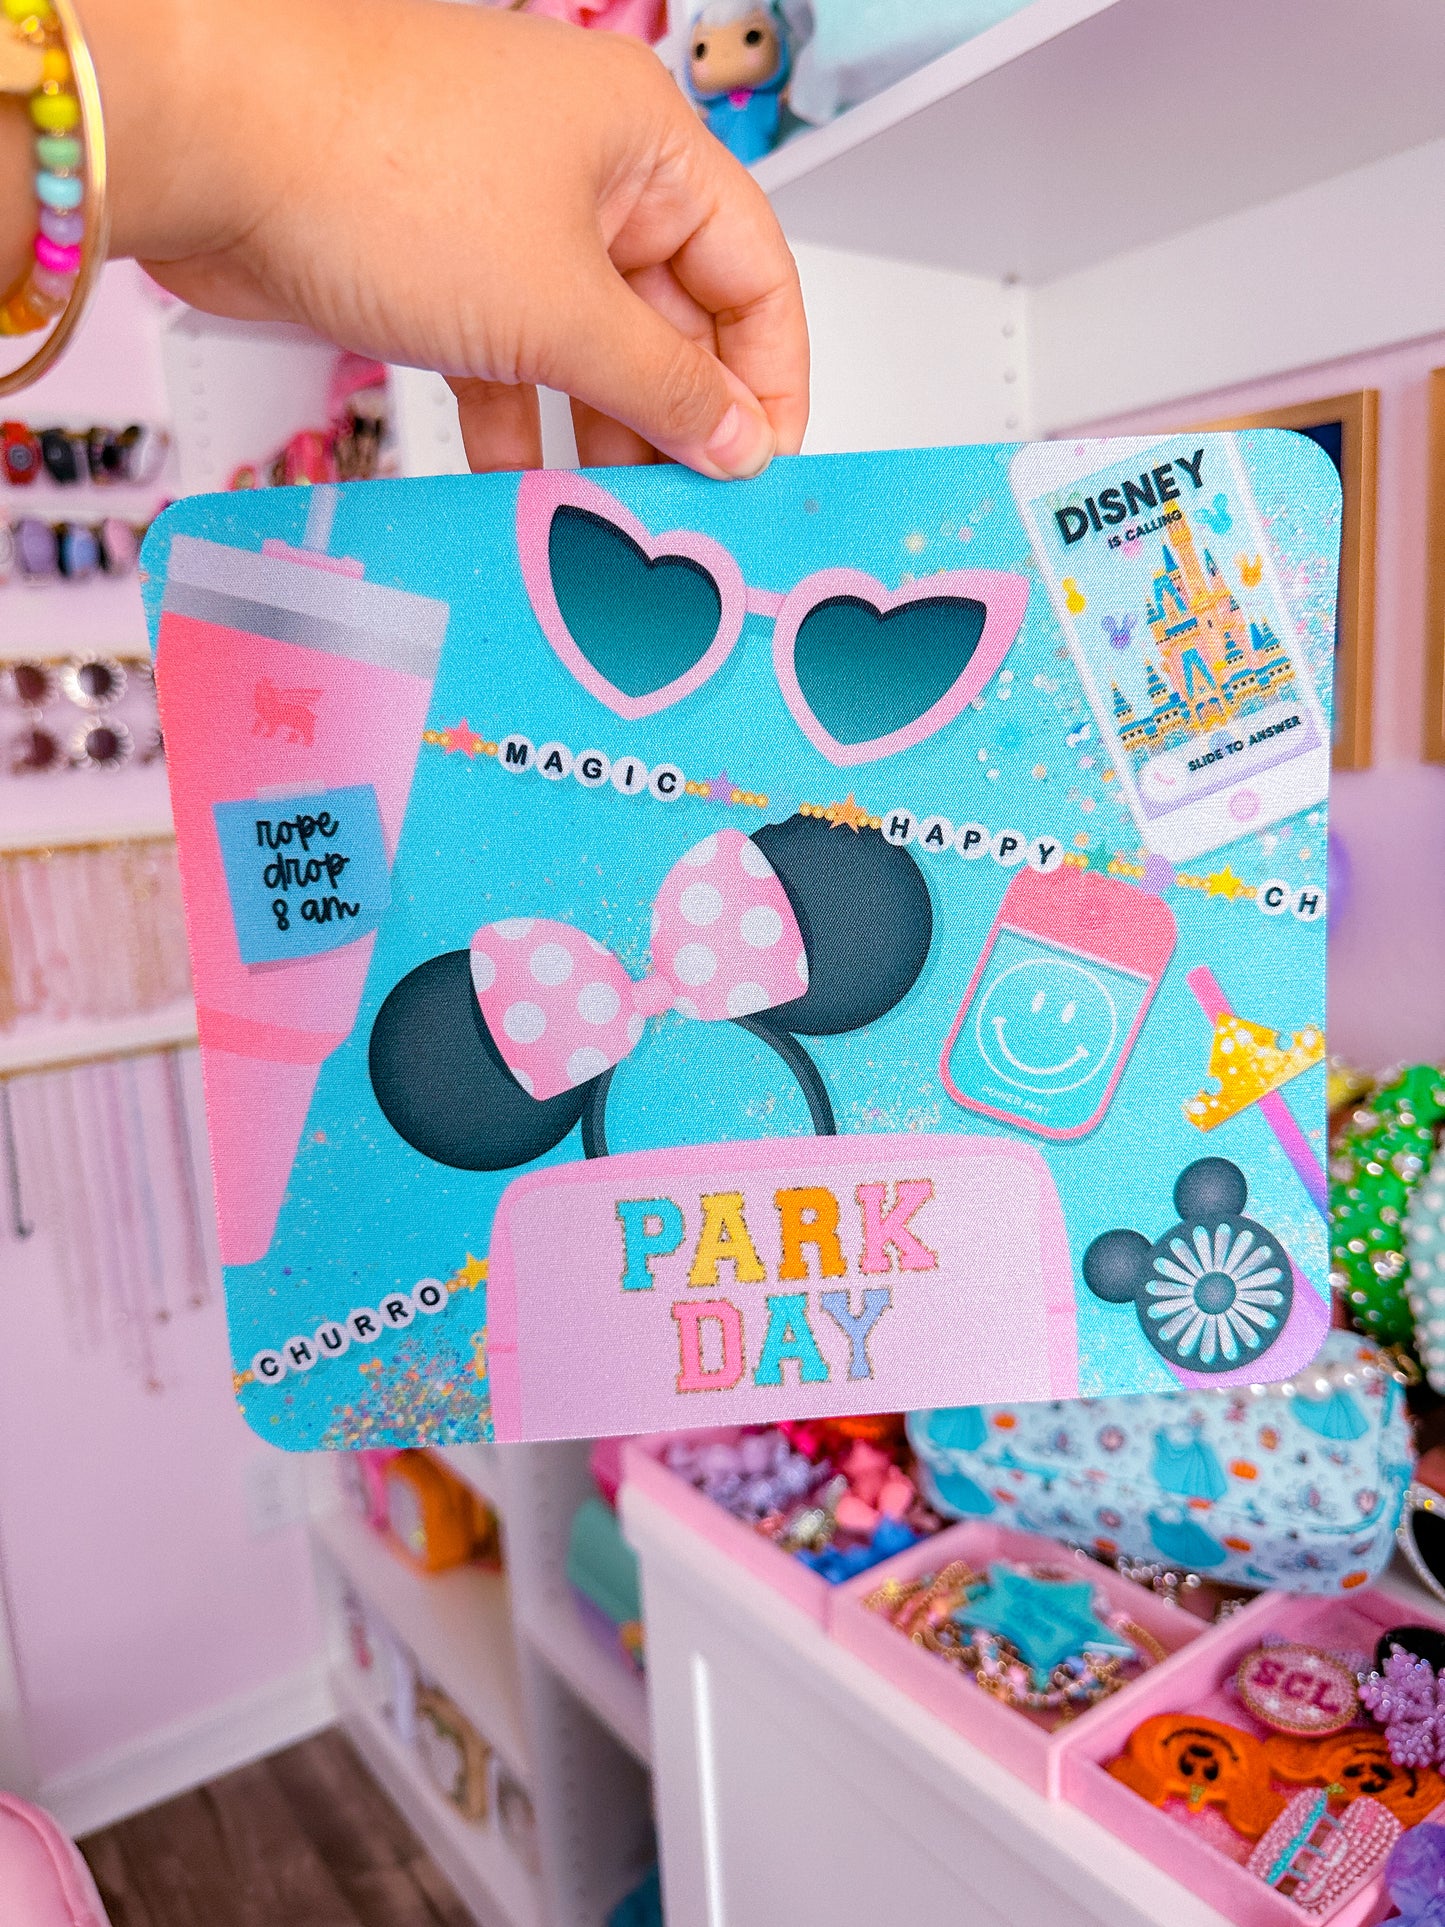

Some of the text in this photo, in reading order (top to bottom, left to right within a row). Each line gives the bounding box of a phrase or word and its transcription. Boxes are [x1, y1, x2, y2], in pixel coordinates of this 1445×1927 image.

[1054, 448, 1205, 546] DISNEY
[1107, 509, 1183, 550] IS CALLING
[1187, 715, 1302, 772] SLIDE TO ANSWER
[256, 811, 339, 851] rope
[505, 741, 1319, 915] MAGIC HAPPY CH
[263, 852, 350, 891] drop
[272, 896, 360, 931] 8 am
[615, 1177, 939, 1293] PARK
[260, 1285, 442, 1377] CHURRO
[671, 1284, 894, 1394] DAY
[1251, 1658, 1341, 1715] SCL
